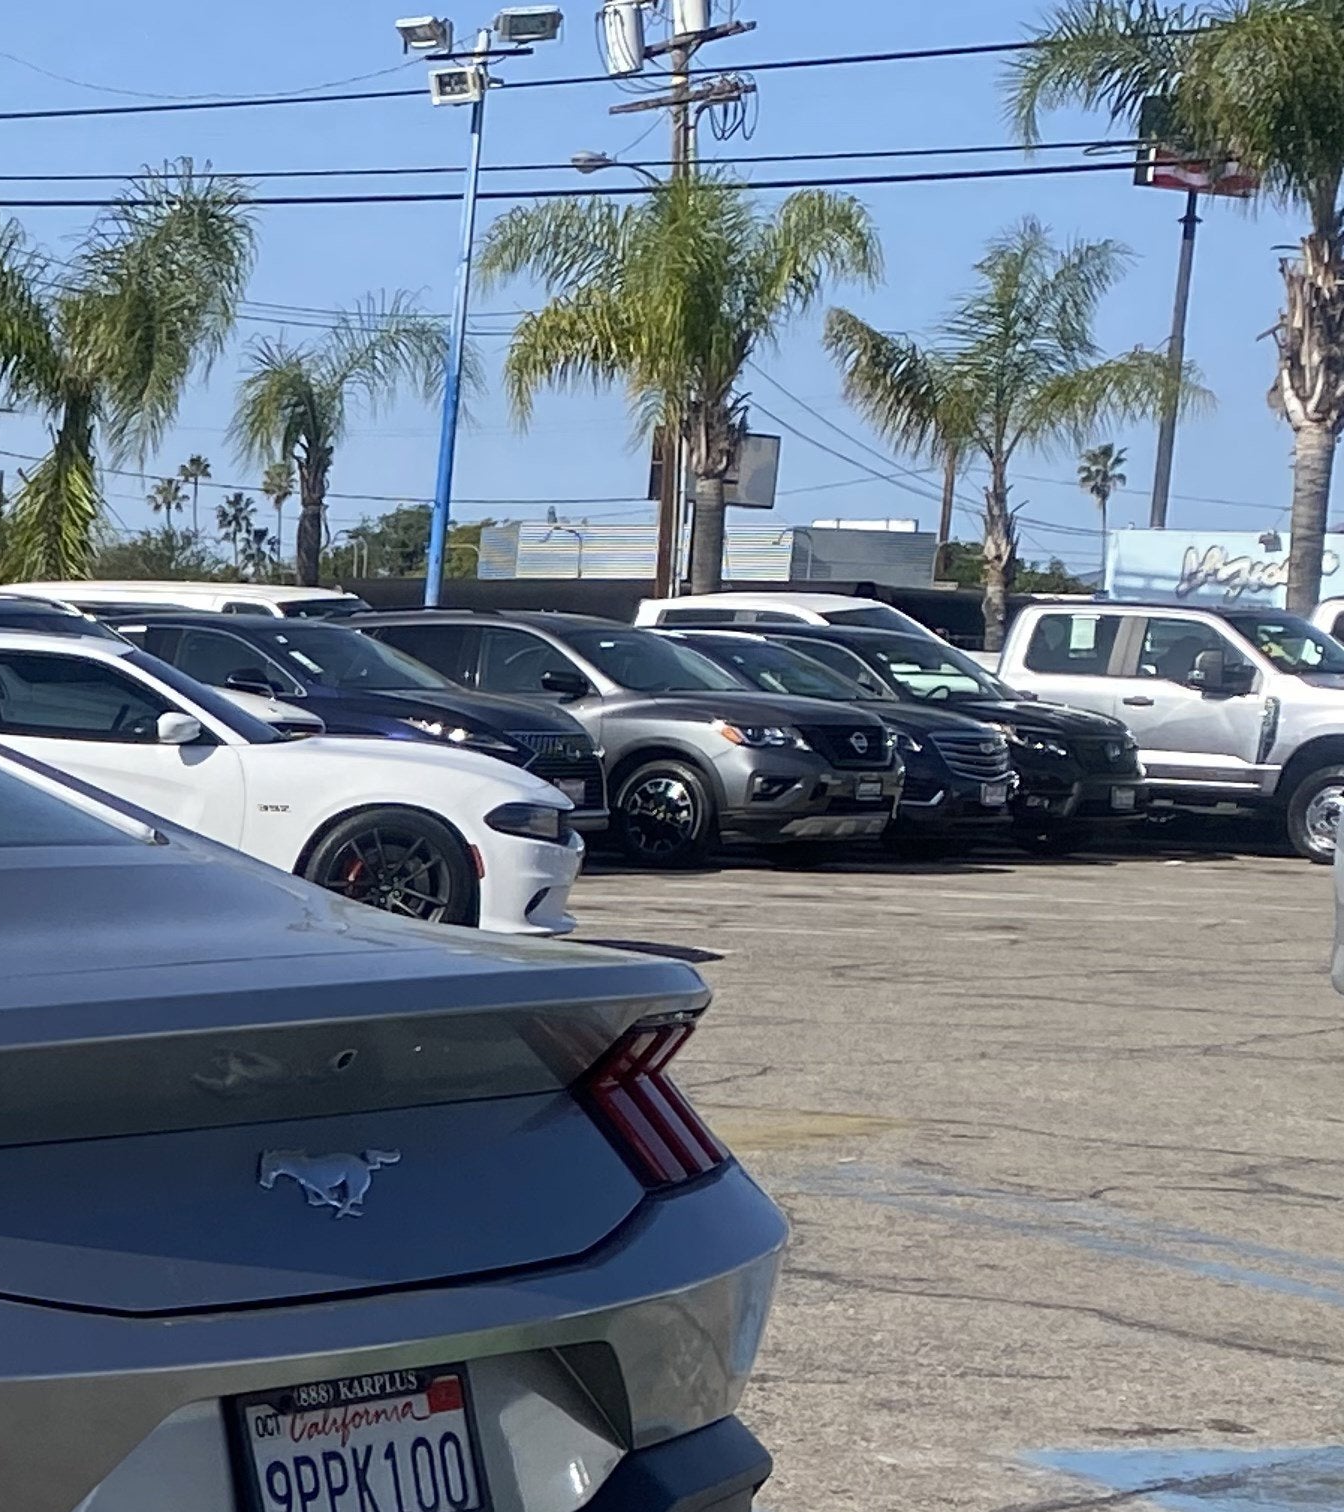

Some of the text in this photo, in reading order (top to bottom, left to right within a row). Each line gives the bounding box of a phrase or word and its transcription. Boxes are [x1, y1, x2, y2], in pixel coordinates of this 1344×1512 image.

[338, 1370, 417, 1400] KARPLUS
[255, 1412, 282, 1438] OCT
[289, 1400, 431, 1448] California
